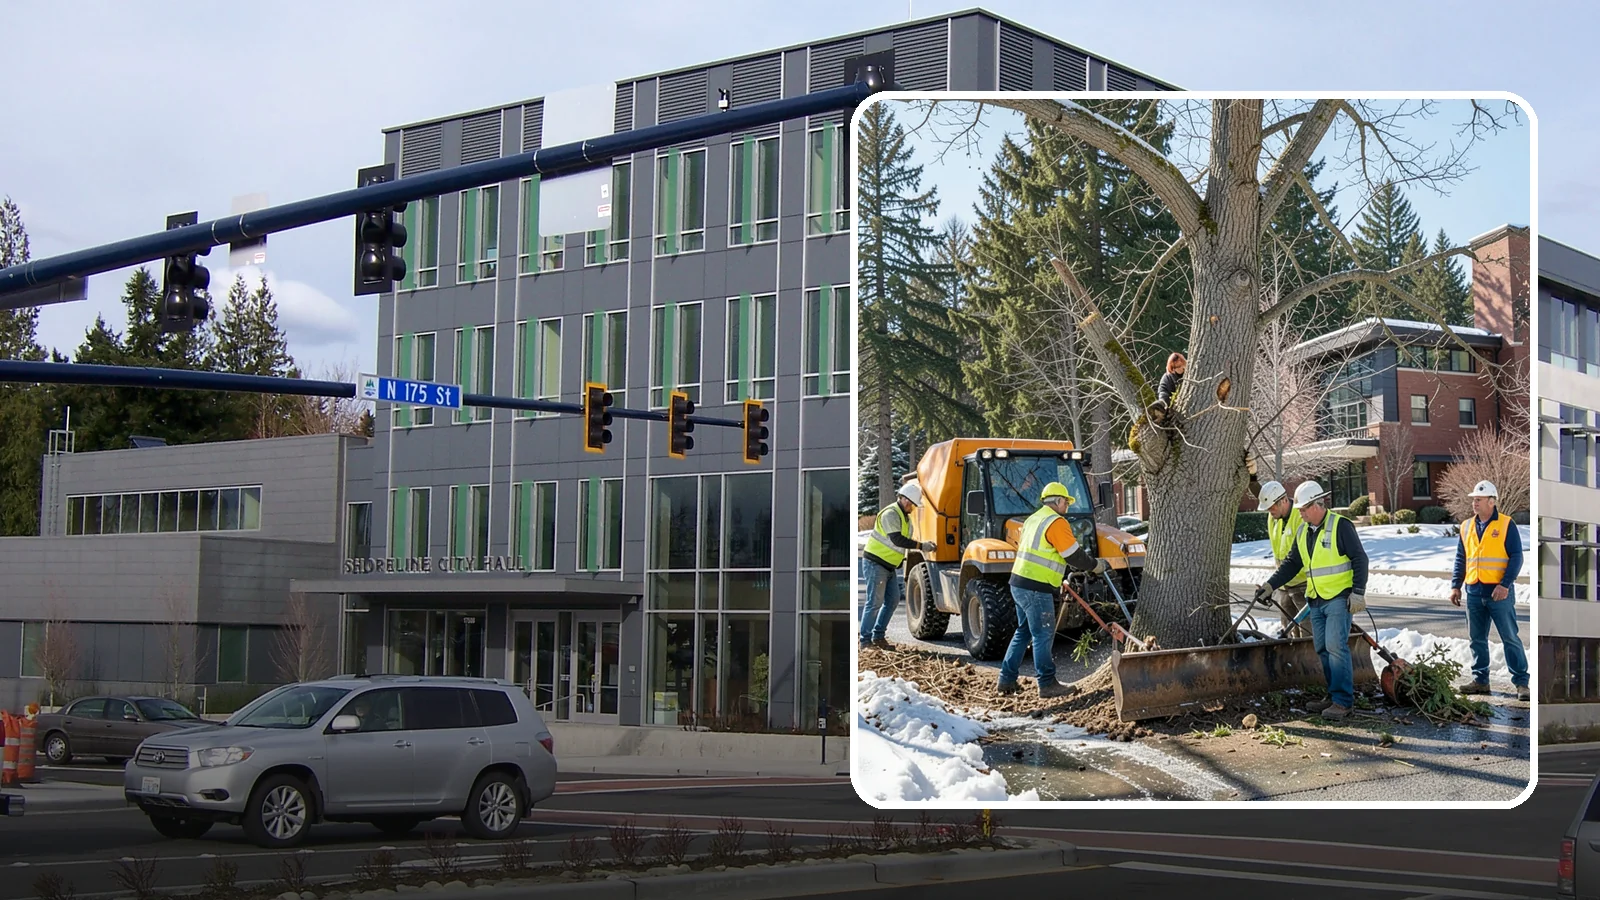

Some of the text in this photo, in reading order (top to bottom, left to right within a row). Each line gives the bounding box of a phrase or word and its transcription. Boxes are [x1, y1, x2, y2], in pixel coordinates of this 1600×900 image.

[387, 380, 451, 406] N 175 St
[344, 555, 526, 574] SHORELINE CITY HALL
